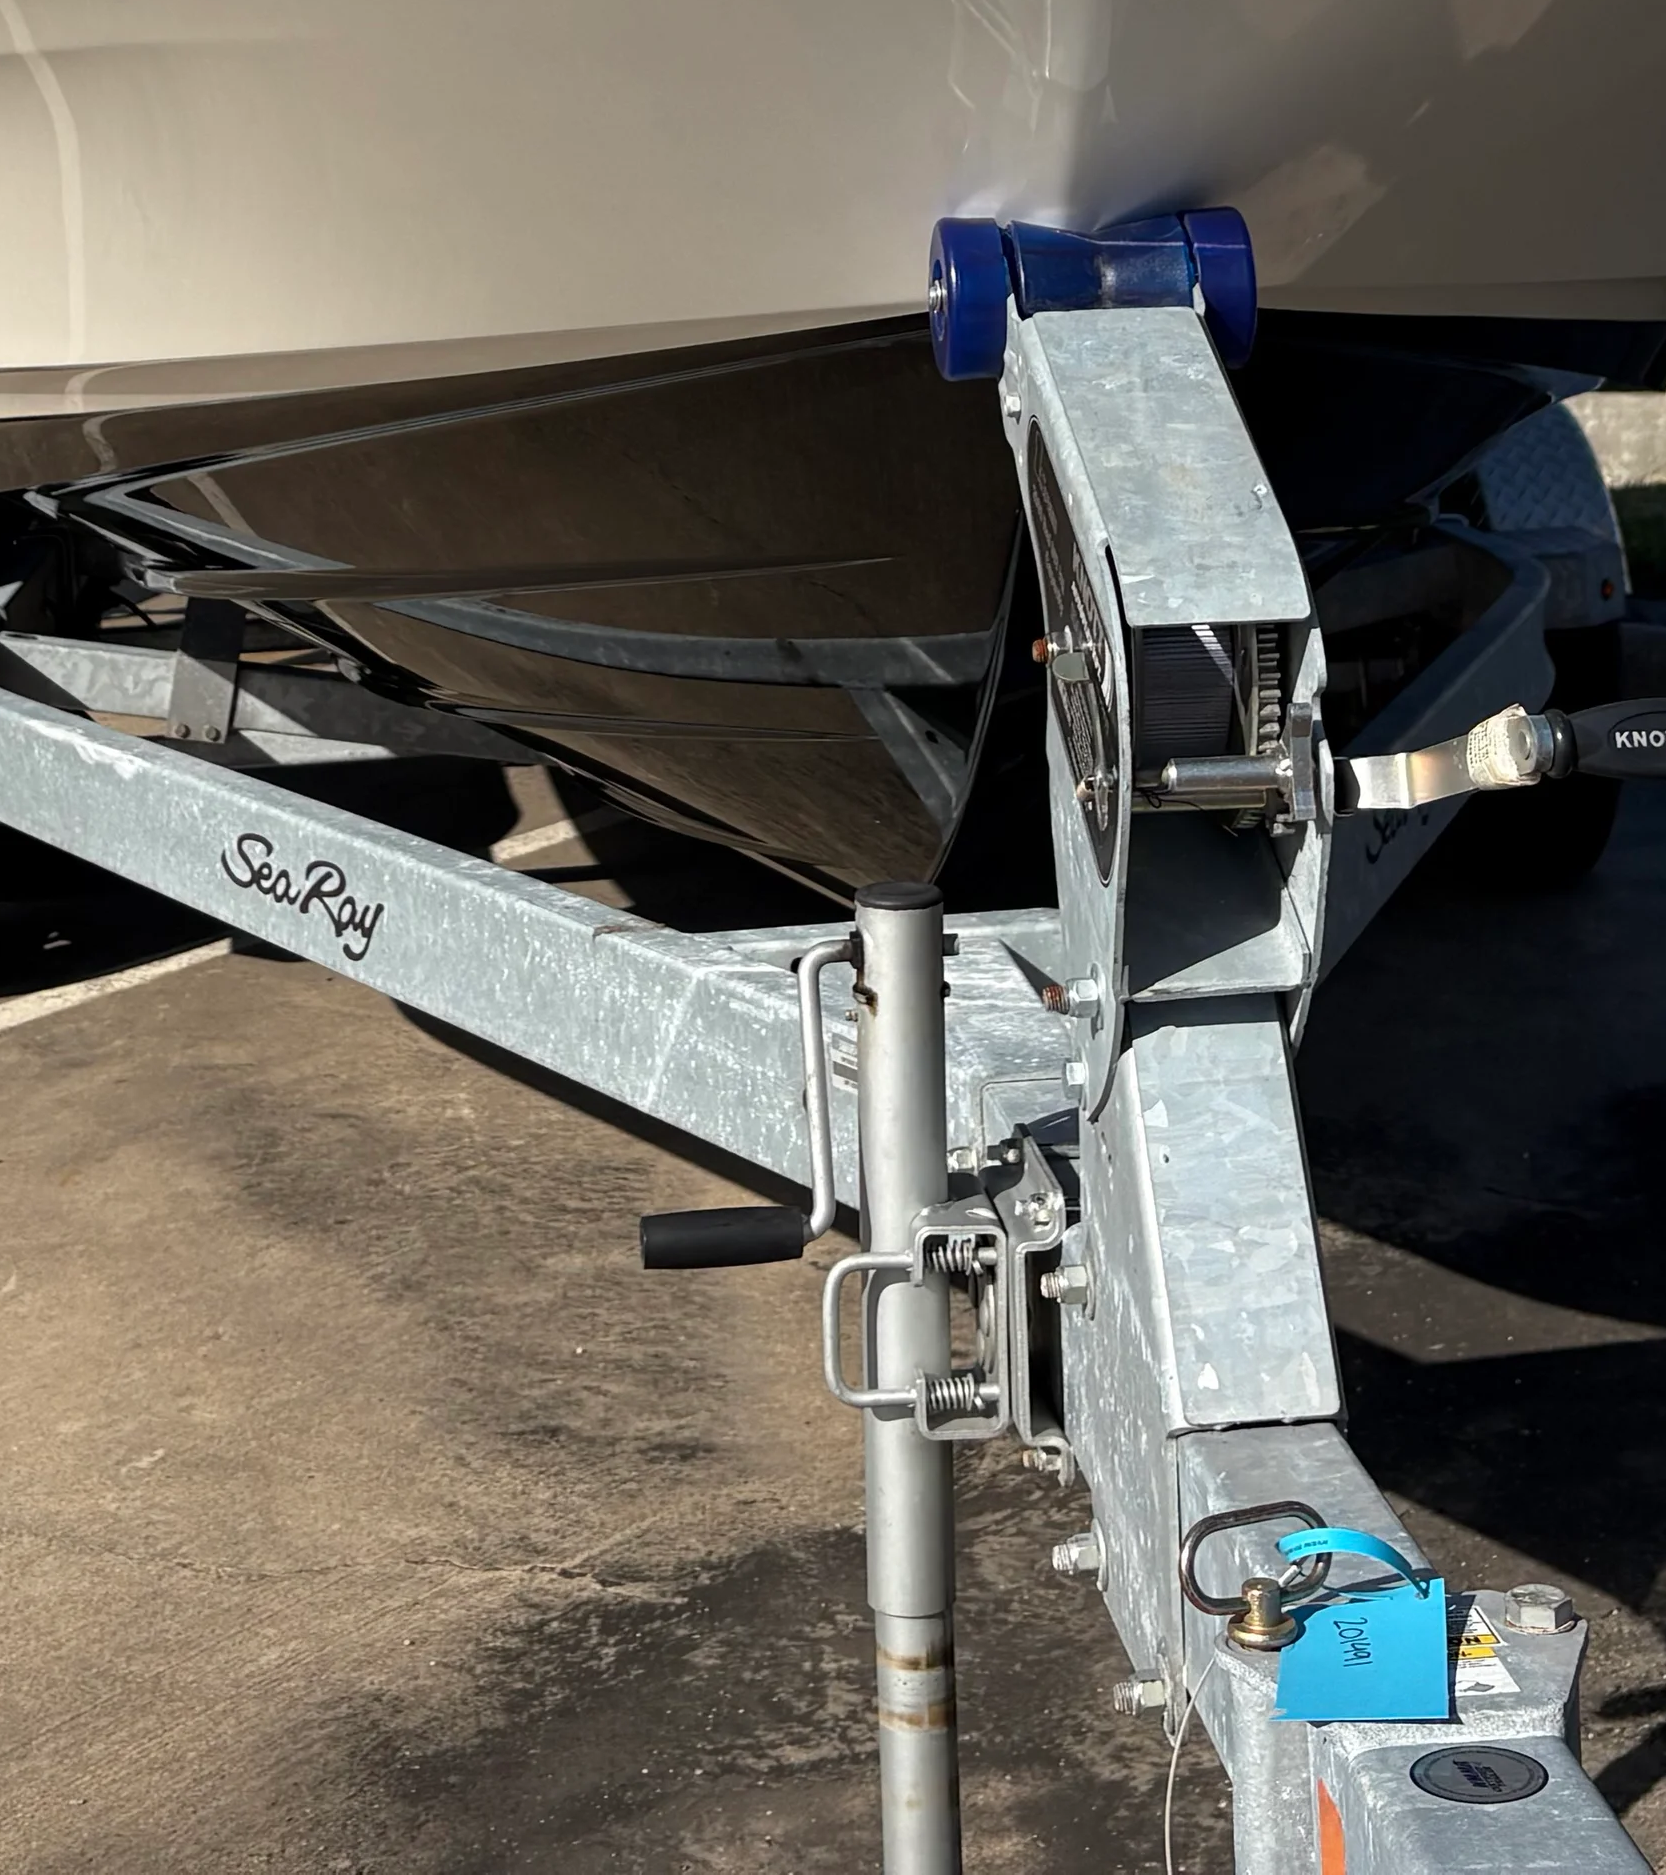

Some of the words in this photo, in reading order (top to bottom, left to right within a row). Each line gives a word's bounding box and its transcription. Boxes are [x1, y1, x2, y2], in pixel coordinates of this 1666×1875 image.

[221, 833, 301, 906] Sea
[299, 860, 385, 962] Ray
[1333, 1616, 1374, 1667] 201491
